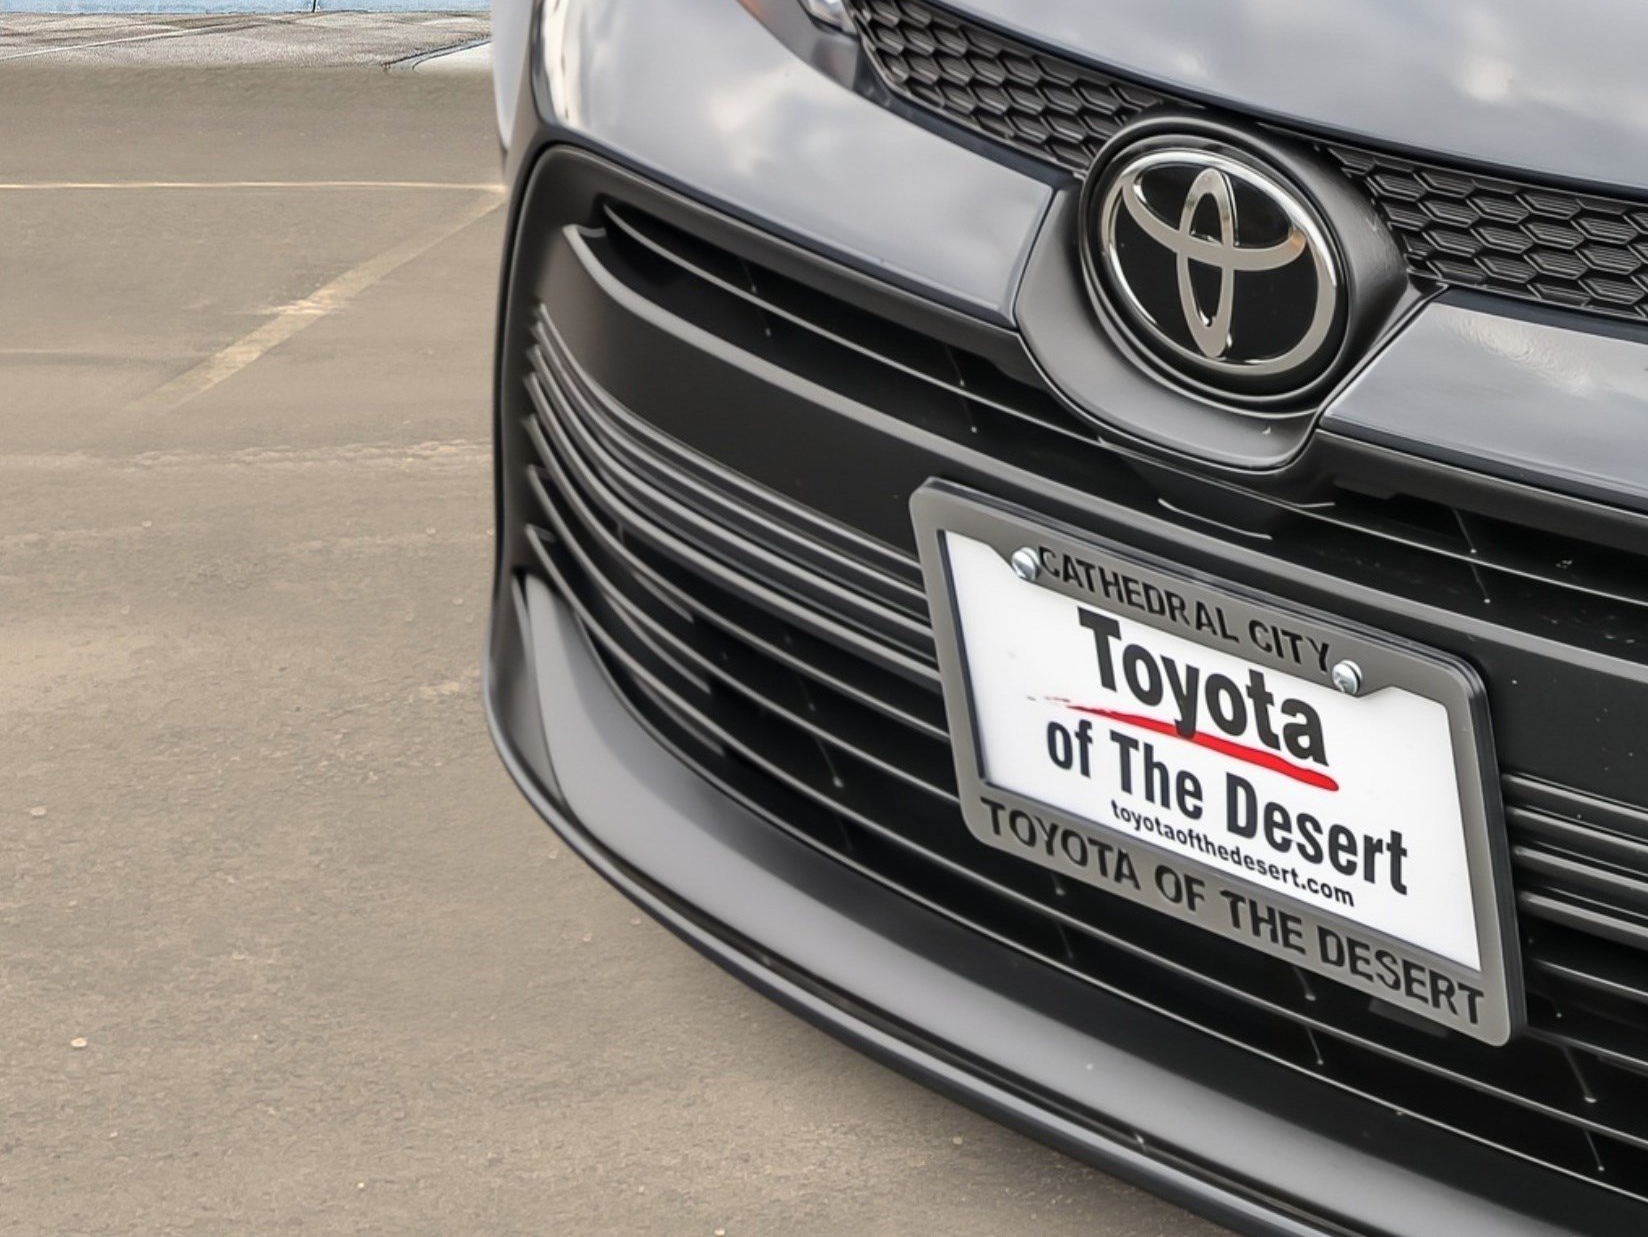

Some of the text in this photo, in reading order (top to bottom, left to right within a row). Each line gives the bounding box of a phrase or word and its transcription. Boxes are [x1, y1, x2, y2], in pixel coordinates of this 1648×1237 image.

[1038, 545, 1331, 672] CATHEDRAL CITY
[1077, 605, 1330, 768] Toyota
[1046, 718, 1409, 896] of The Desert
[1110, 798, 1355, 908] toyotaofthedesert.com
[980, 795, 1486, 1026] TOYOTA OF THE DESERT
